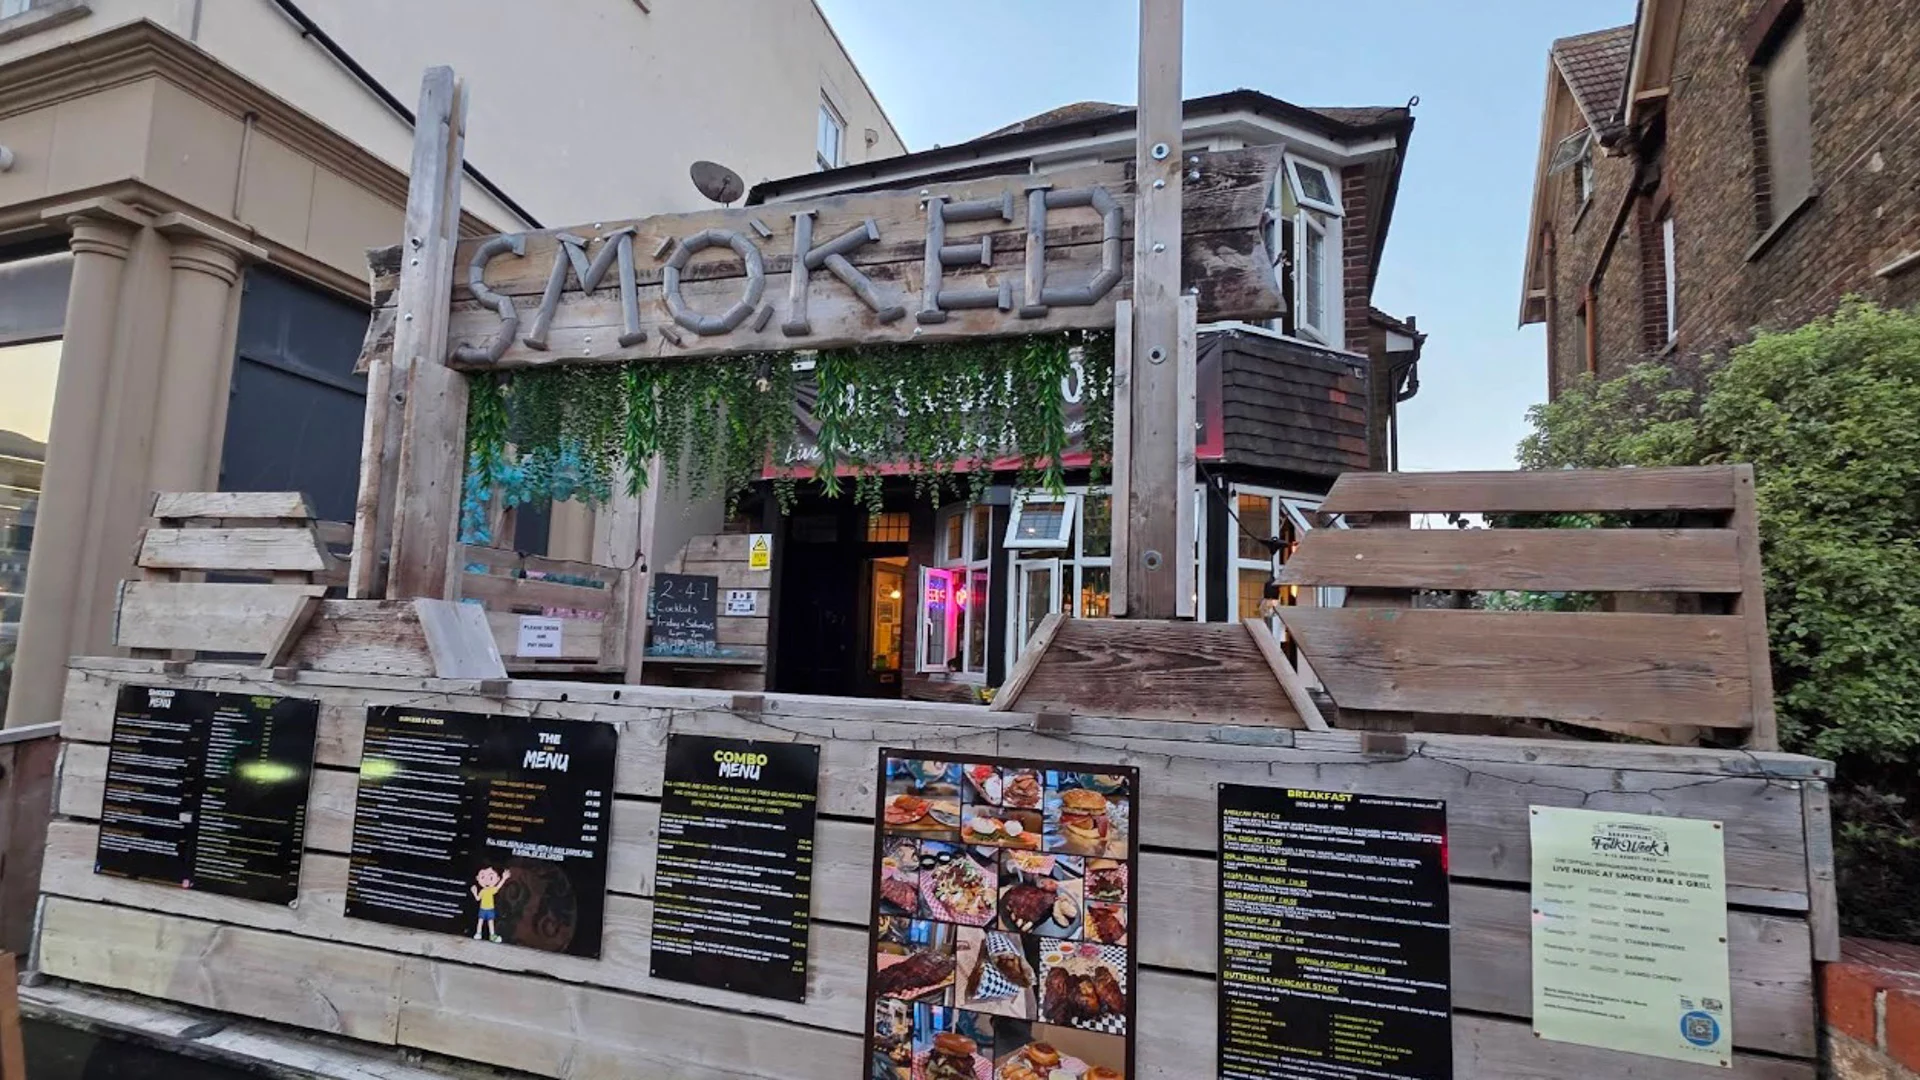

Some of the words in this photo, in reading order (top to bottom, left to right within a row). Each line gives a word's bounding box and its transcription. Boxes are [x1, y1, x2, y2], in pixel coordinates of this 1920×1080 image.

[452, 184, 1123, 364] SMOKED
[148, 698, 172, 709] MENU
[538, 733, 562, 745] THE
[523, 750, 570, 772] MENU
[713, 750, 768, 766] COMBO
[718, 761, 761, 780] MENU
[1287, 789, 1353, 802] BREAKFAST
[1591, 835, 1624, 851] Folk
[1622, 839, 1665, 857] Week
[1553, 866, 1570, 874] LIVE
[1572, 867, 1601, 877] MUSIC
[1615, 872, 1654, 882] SMOKED
[1656, 877, 1674, 885] BAR
[1685, 880, 1712, 889] GRILL
[1223, 971, 1273, 984] BUTTERMILK
[1273, 976, 1312, 990] PANCAKE
[1312, 982, 1340, 995] STACK
